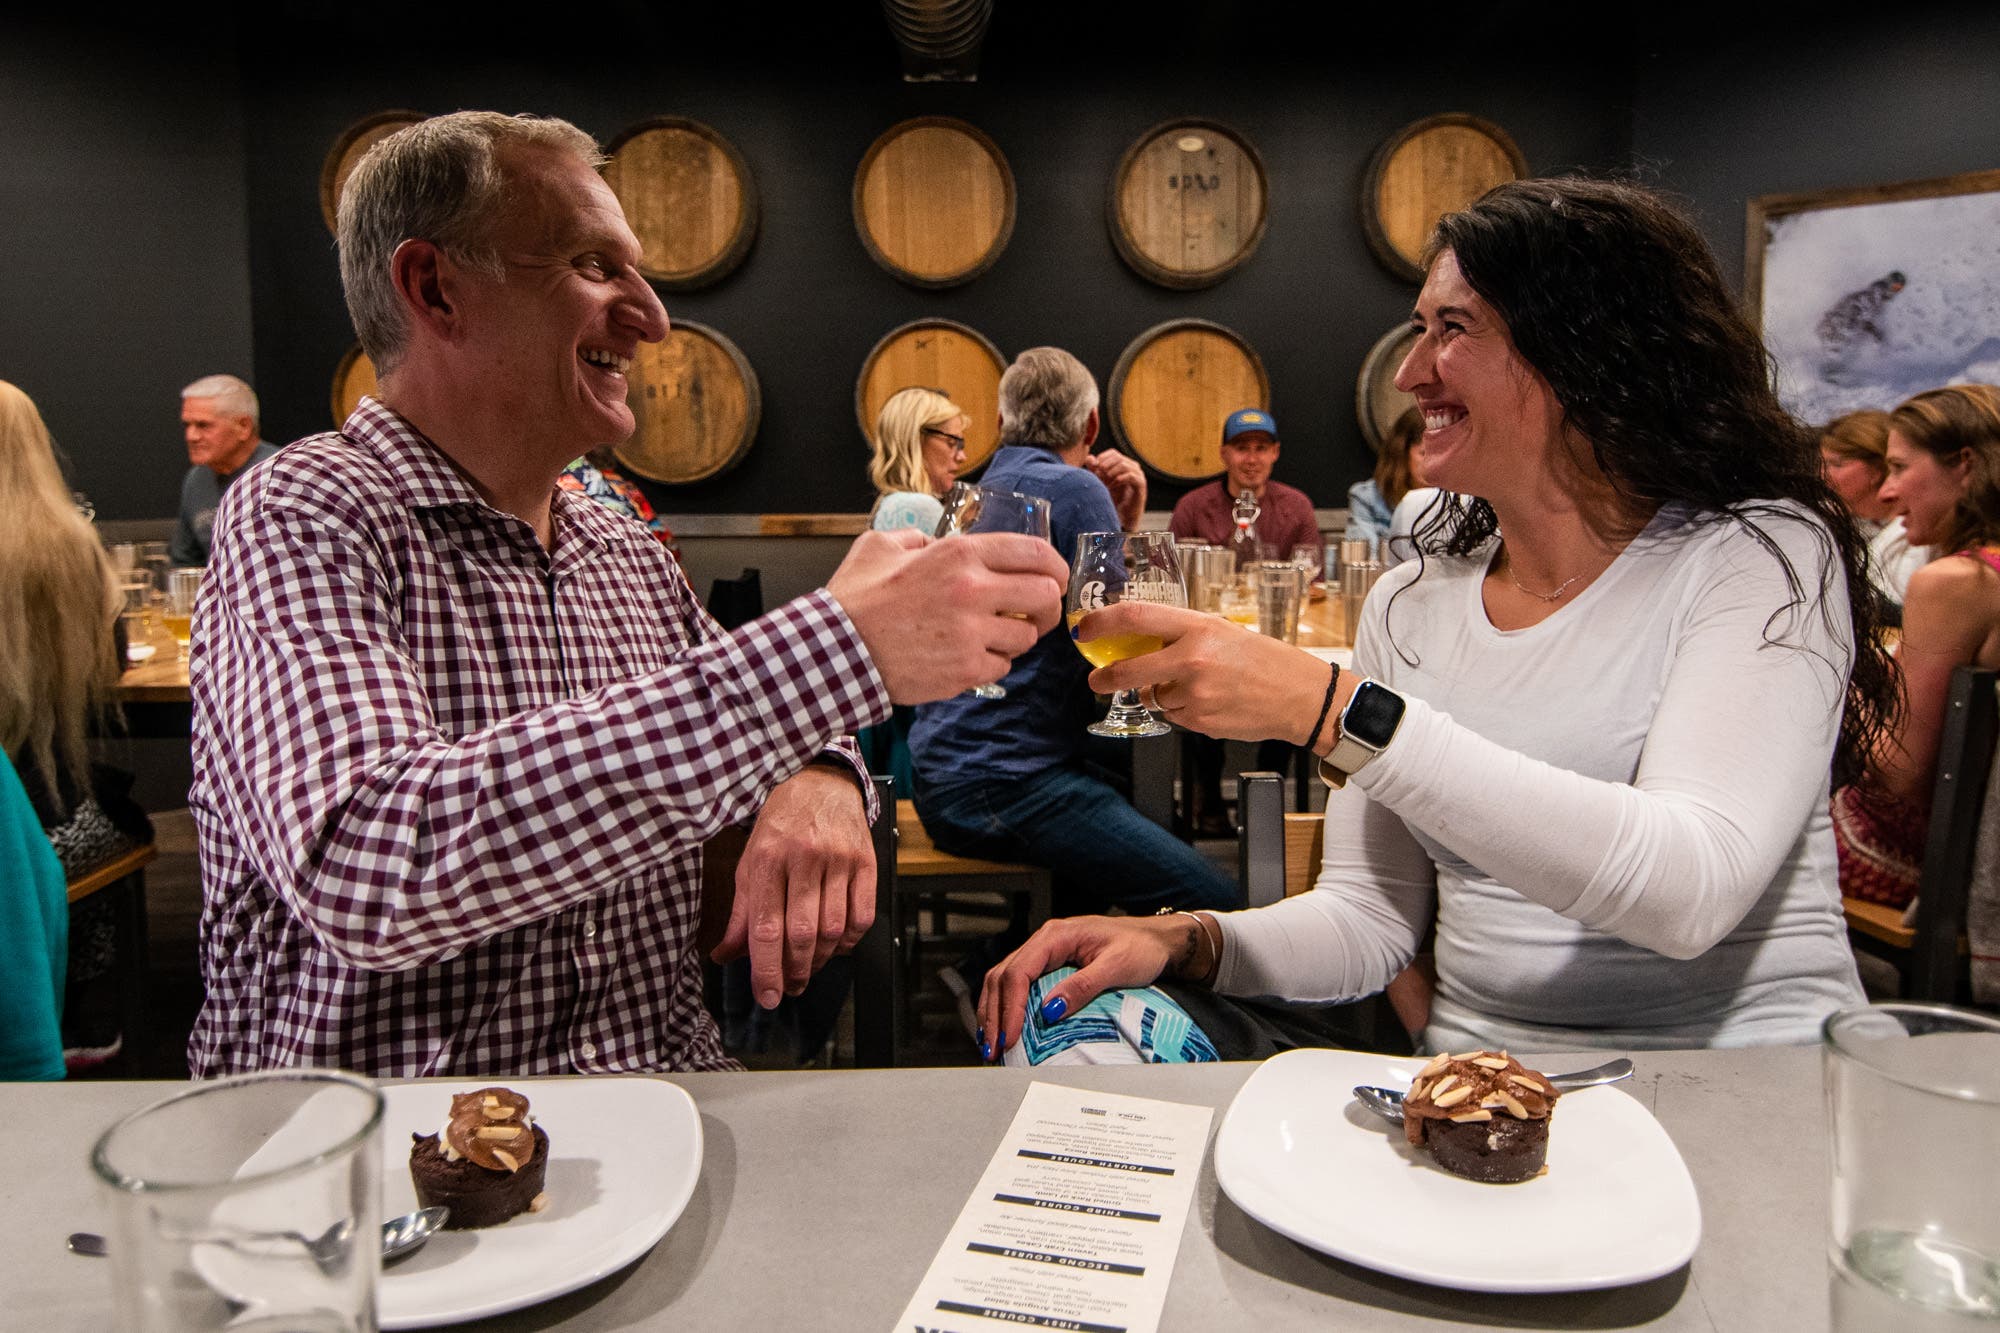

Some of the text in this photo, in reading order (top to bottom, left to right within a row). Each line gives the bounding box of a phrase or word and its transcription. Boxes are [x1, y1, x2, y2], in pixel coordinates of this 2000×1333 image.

[1050, 1155, 1143, 1170] FOURTH COURSE
[1089, 1151, 1128, 1159] Chocolate
[1033, 1200, 1121, 1216] THIRD COURSE
[1067, 1247, 1097, 1255] Tavern
[1002, 1249, 1109, 1270] SECOND COURSE
[983, 1296, 1080, 1315] Citrus Arugula Salad
[982, 1309, 1080, 1330] FIRST COURSE
